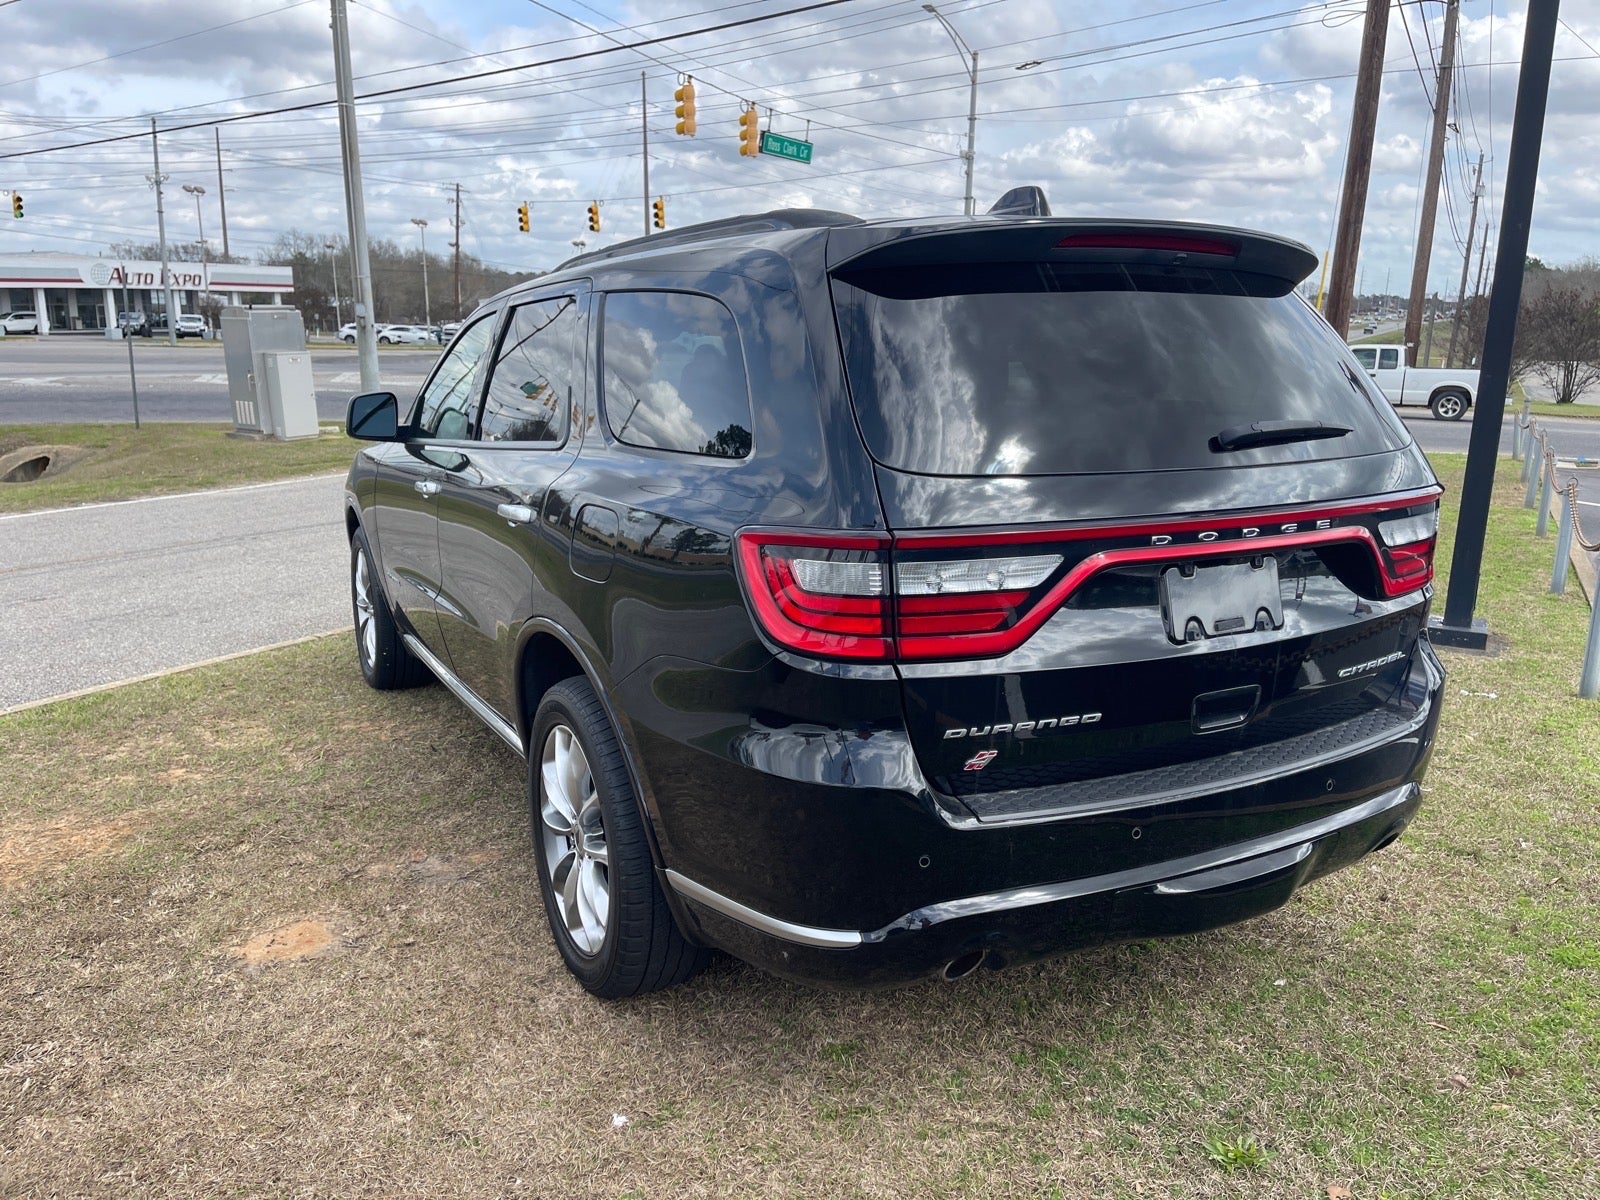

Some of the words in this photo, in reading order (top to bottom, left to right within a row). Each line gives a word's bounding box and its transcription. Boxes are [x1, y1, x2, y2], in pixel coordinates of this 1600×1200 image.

[767, 137, 781, 152] Ross
[783, 141, 797, 156] Clark
[799, 146, 809, 158] Cir
[108, 267, 154, 286] AUTO
[1150, 519, 1332, 545] DODGE
[1338, 651, 1406, 678] CITADEL
[943, 712, 1103, 740] DURANGO
